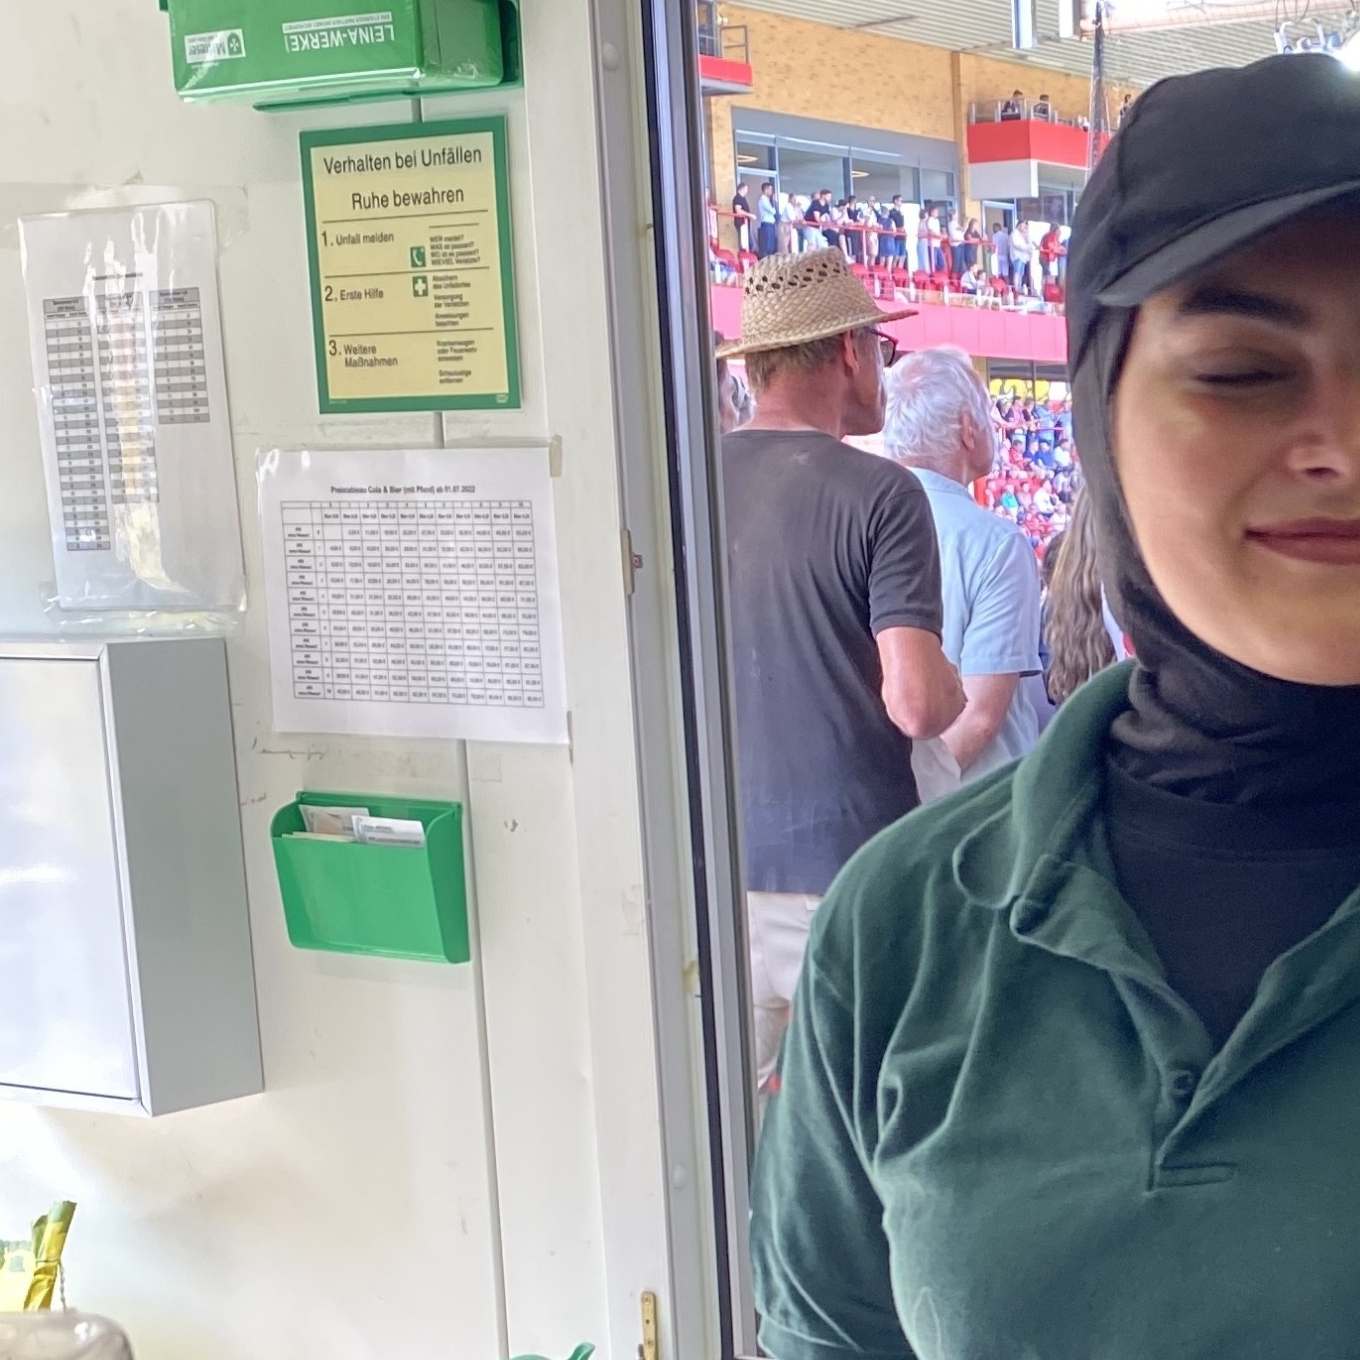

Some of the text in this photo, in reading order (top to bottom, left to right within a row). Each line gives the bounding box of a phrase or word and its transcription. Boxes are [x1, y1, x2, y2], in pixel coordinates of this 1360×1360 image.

[289, 24, 395, 52] LEINA-WERKE
[323, 146, 482, 175] Verhalten bei Unfällen
[352, 186, 464, 210] Ruhe bewahren
[321, 231, 395, 247] 1. Unfall melden
[324, 286, 384, 302] 2. Erste Hilfe
[328, 339, 377, 356] 3. Weitere
[344, 356, 398, 368] Maßnahmen
